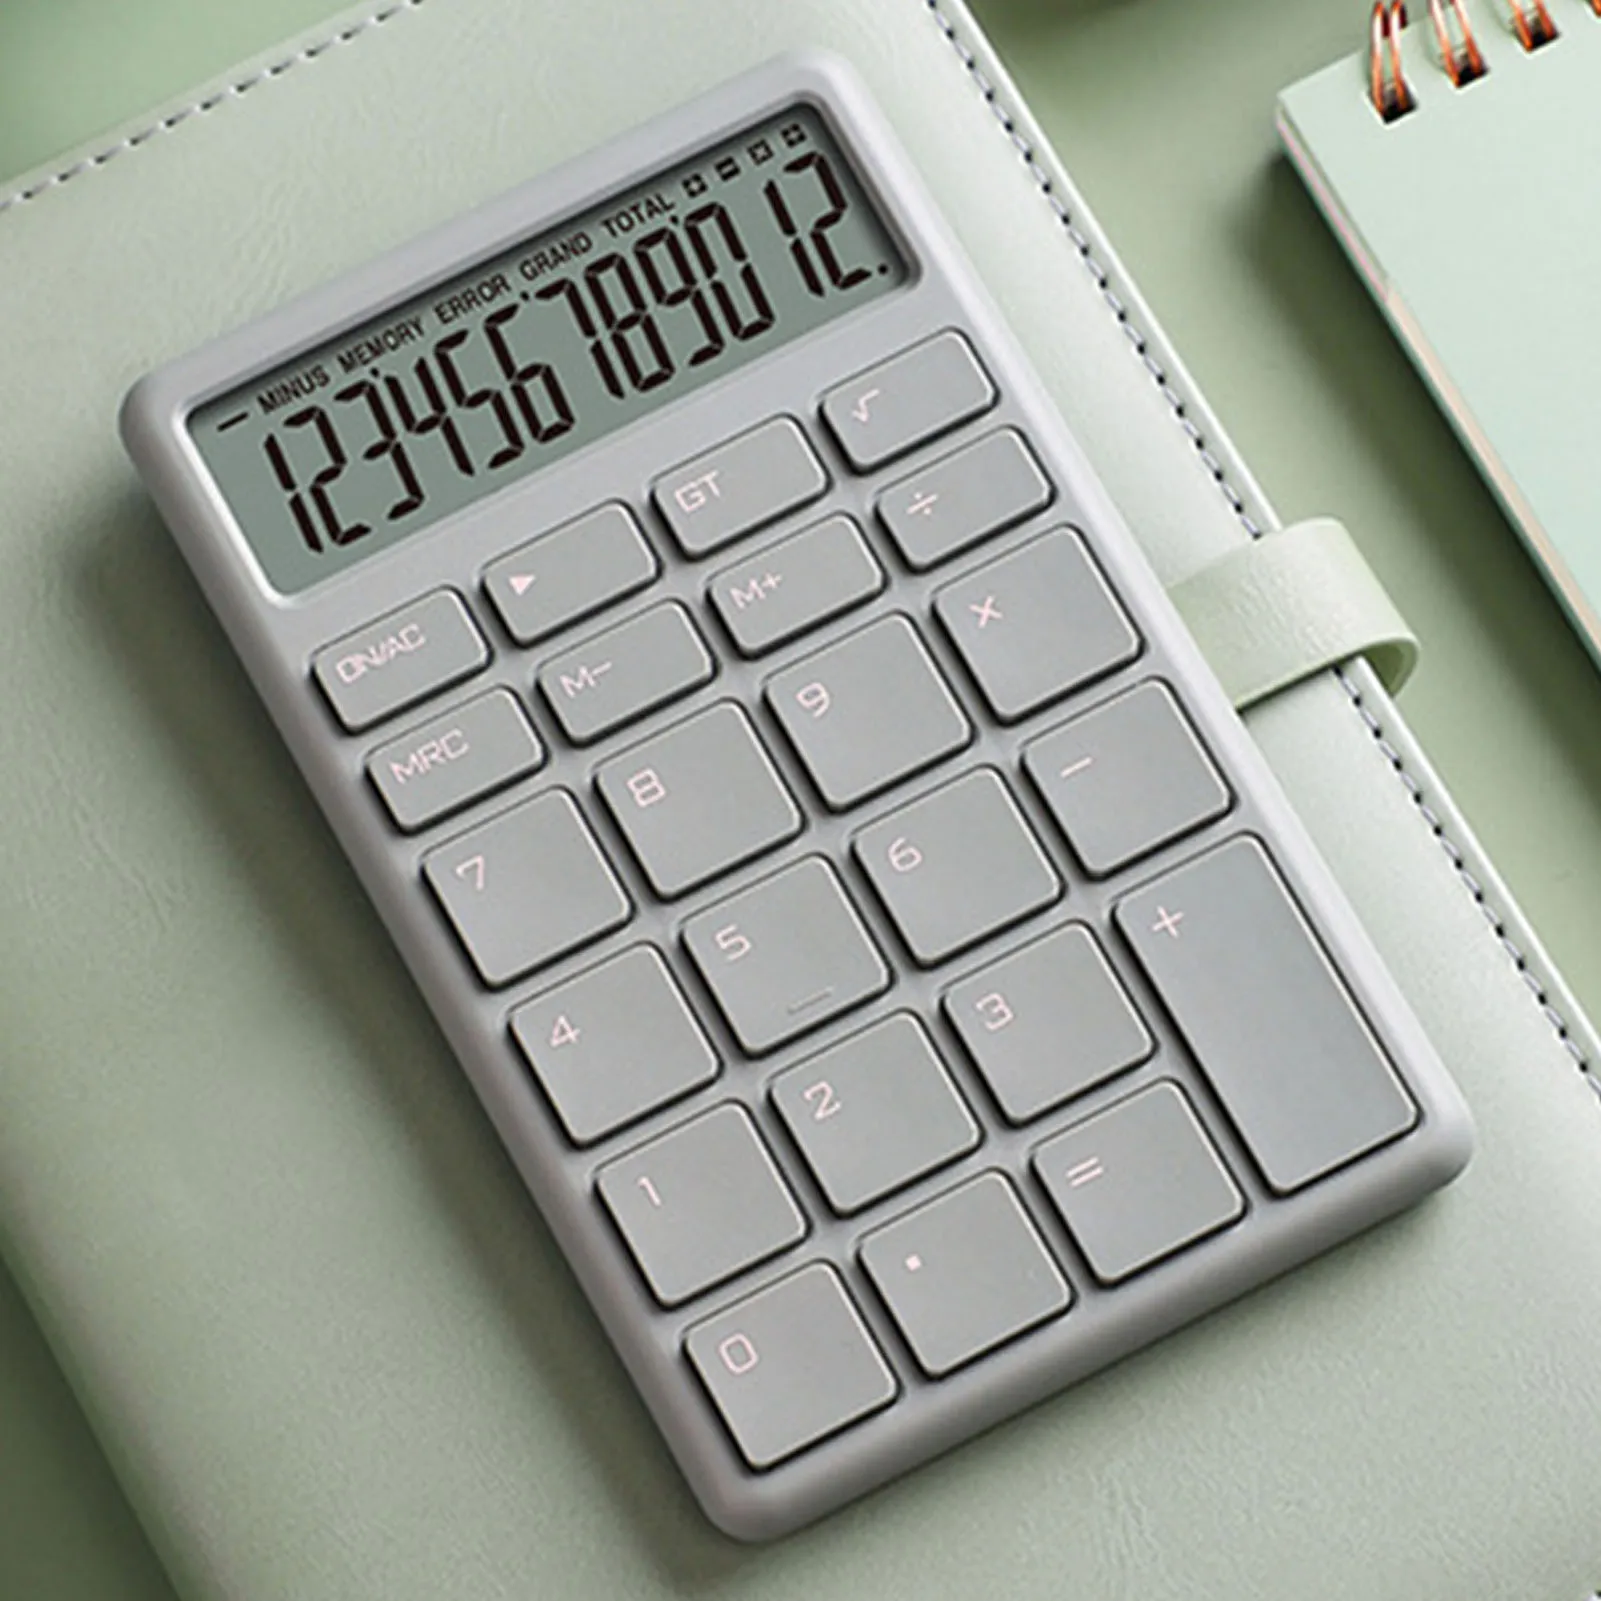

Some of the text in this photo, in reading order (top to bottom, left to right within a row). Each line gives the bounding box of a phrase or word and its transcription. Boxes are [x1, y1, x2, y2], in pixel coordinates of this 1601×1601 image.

[257, 193, 676, 415] MINUS MEMORY ERROR GRAND TOTAL
[674, 471, 721, 512] GT
[730, 572, 782, 609] M+
[796, 682, 829, 718] 9
[390, 728, 469, 784] MRC
[626, 769, 666, 808] 8
[456, 855, 486, 890] 7
[887, 838, 922, 872] 6
[715, 924, 752, 961] 5
[974, 993, 1014, 1030] 3
[549, 1015, 580, 1047] 4
[804, 1081, 842, 1120] 2
[637, 1177, 661, 1207] 1
